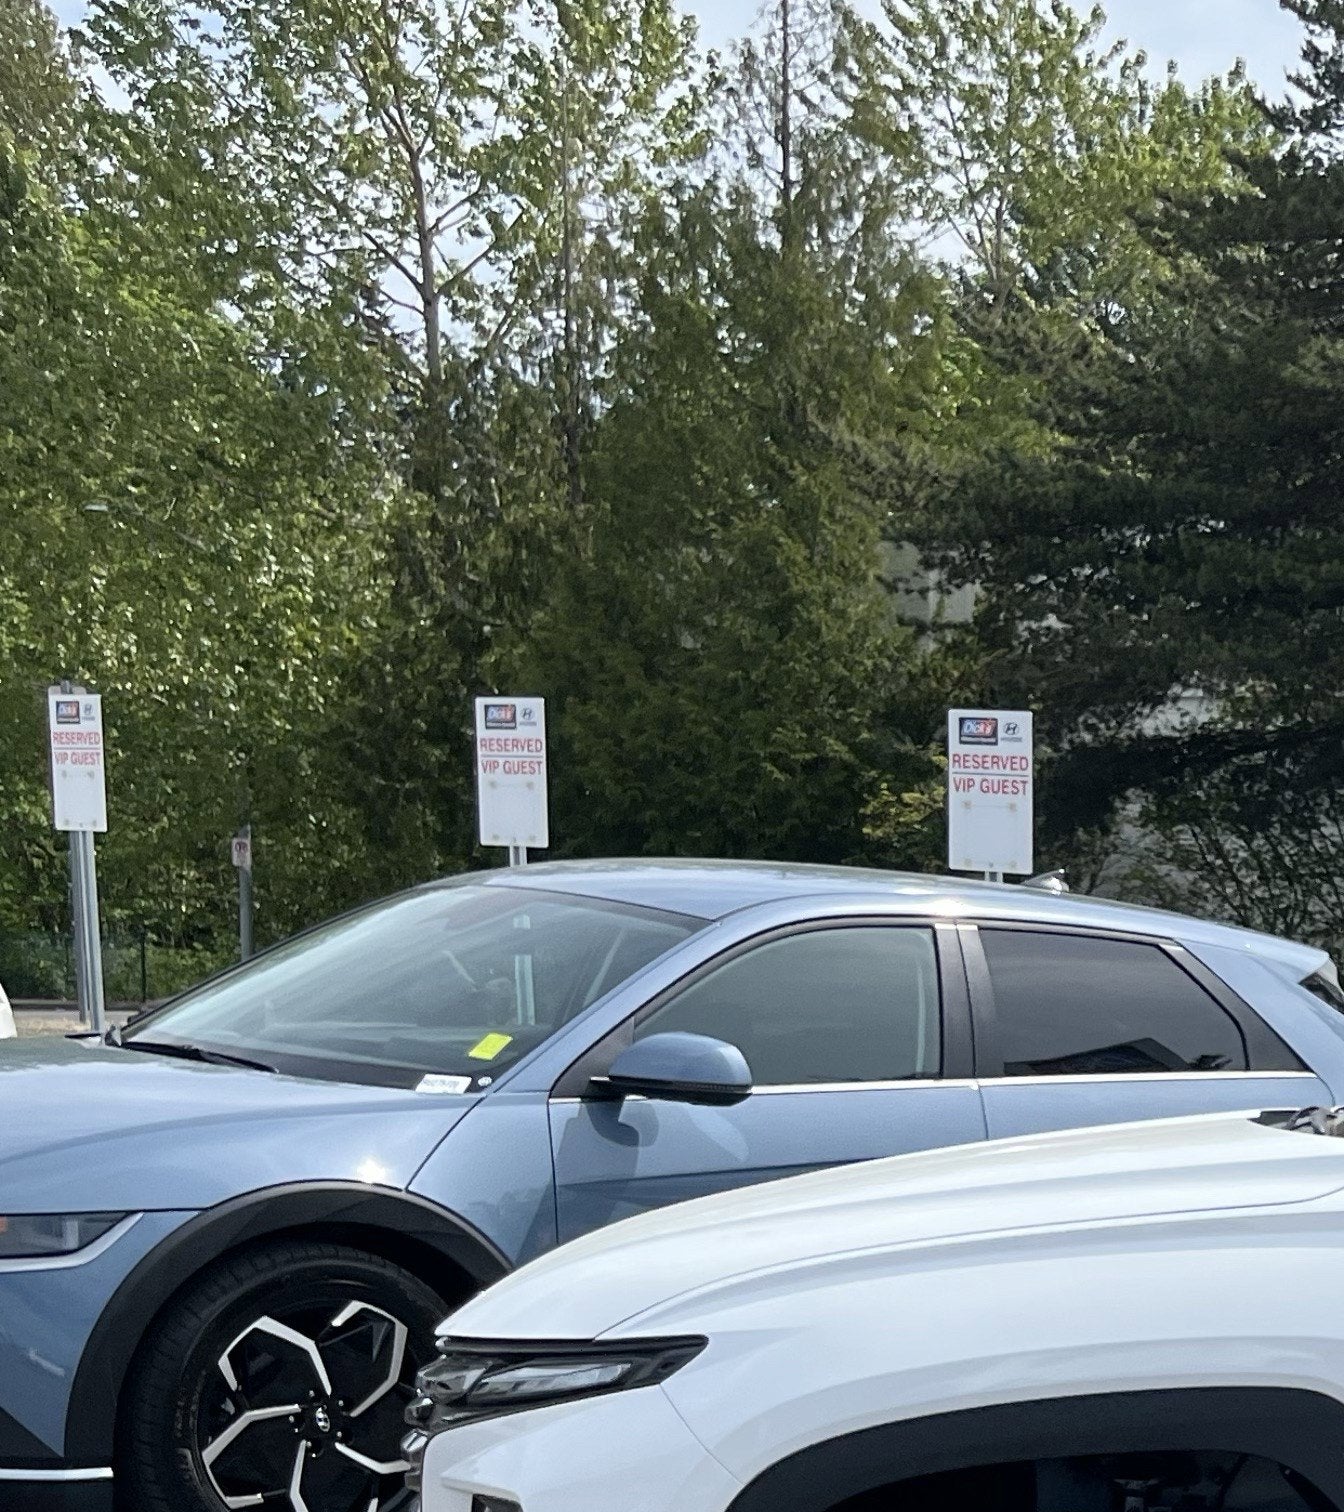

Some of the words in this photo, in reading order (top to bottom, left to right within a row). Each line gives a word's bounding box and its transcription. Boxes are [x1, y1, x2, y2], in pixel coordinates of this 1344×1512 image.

[53, 732, 101, 745] RESERVED
[480, 739, 543, 753] RESERVED
[54, 752, 69, 765] VIP
[70, 752, 100, 766] GUEST
[952, 754, 1029, 771] RESERVED
[481, 760, 499, 774] VIP
[503, 760, 542, 775] GUEST
[953, 777, 975, 793] VIP
[980, 778, 1028, 796] GUEST
